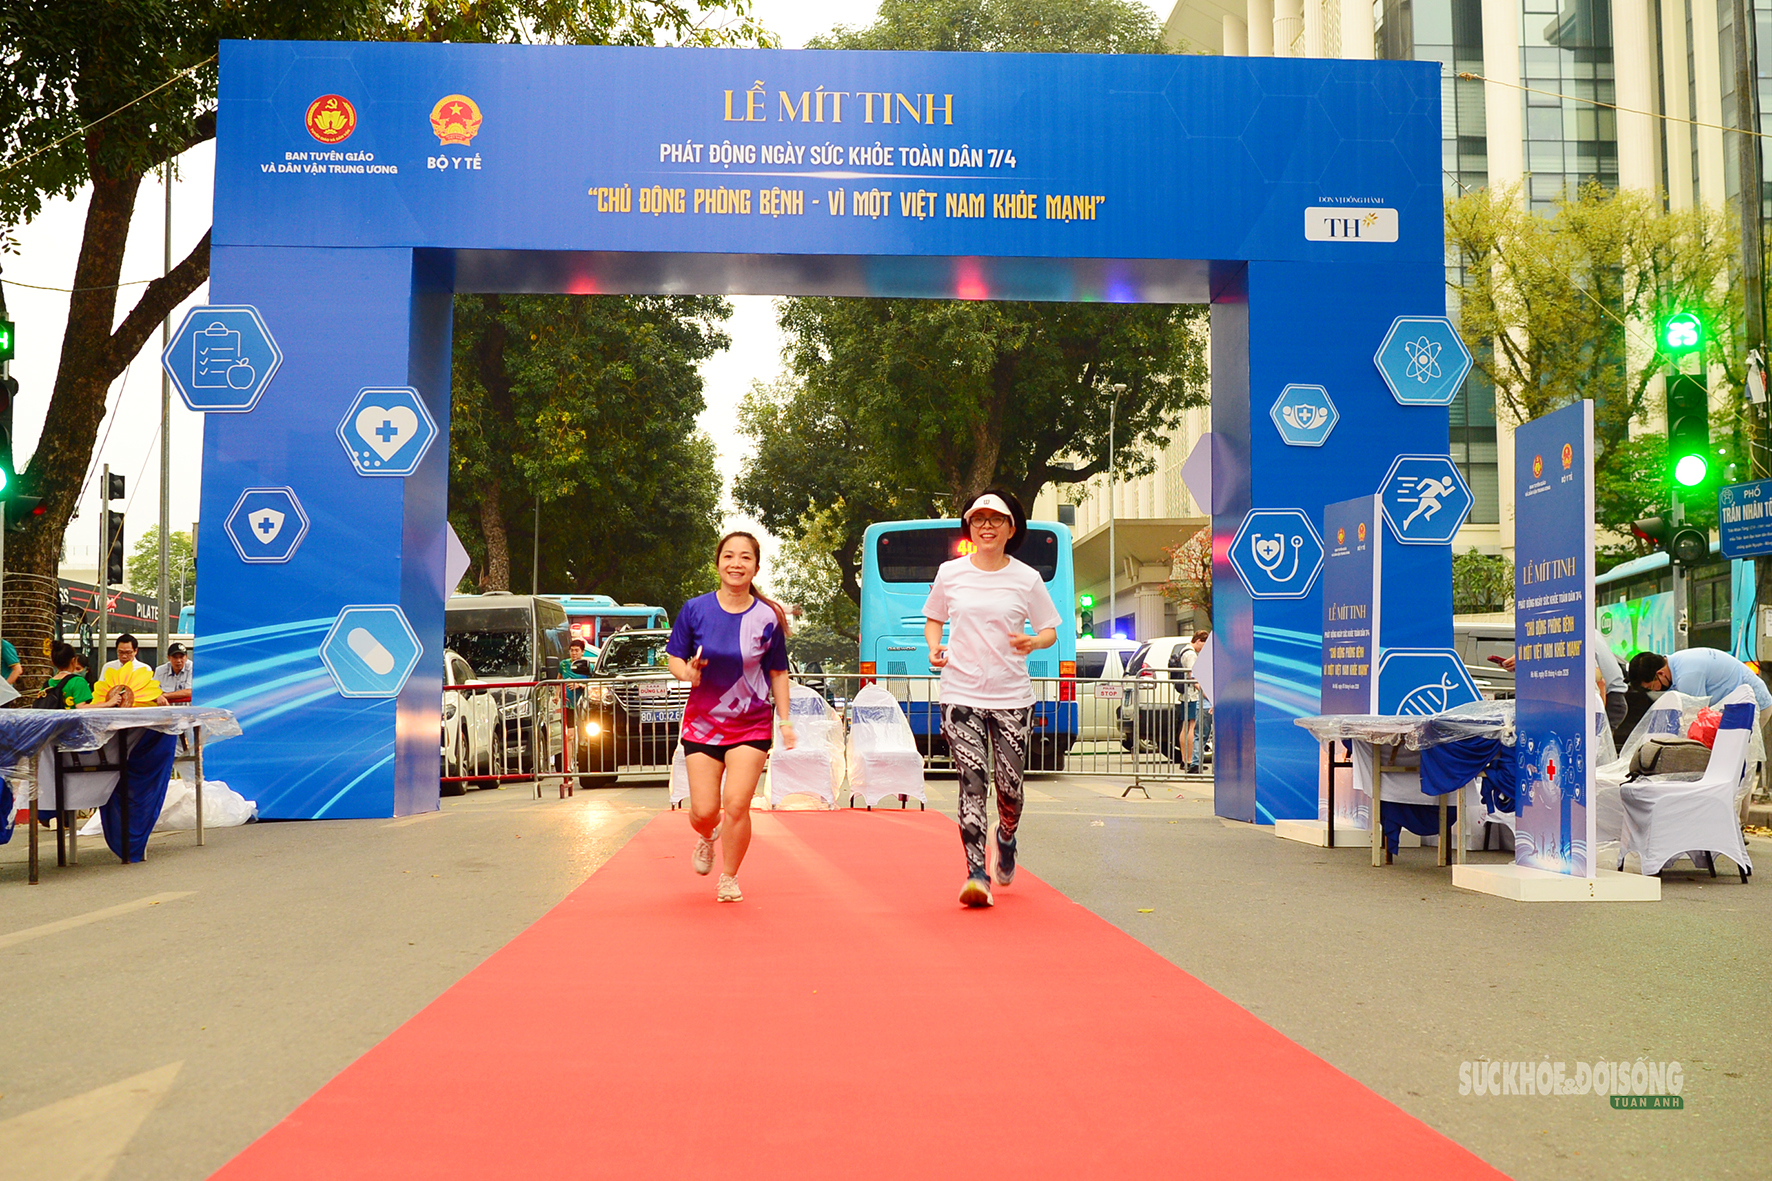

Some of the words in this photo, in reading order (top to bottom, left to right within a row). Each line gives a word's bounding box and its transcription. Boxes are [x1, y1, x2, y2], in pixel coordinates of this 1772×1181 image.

[723, 79, 767, 122] LỄ
[778, 85, 850, 123] MÍT
[856, 92, 954, 125] TINH
[285, 152, 308, 161] BAN
[309, 150, 344, 161] TUYÊN
[345, 150, 374, 162] GIÁO
[427, 154, 449, 172] BỘ
[451, 157, 463, 169] Y
[464, 152, 482, 170] TẾ
[660, 139, 704, 163] PHÁT
[709, 139, 756, 169] ĐỘNG
[761, 141, 805, 165] NGÀY
[810, 141, 844, 165] SỨC
[848, 141, 894, 166] KHỎE
[899, 143, 944, 167] TOÀN
[949, 144, 983, 168] DÂN
[987, 149, 1017, 168] 7/4
[261, 162, 277, 173] VÀ
[278, 162, 301, 173] DÂN
[303, 162, 326, 176] VẬN
[328, 164, 365, 174] TRUNG
[366, 164, 398, 174] ƯƠNG
[639, 185, 686, 216] ĐỘNG
[693, 186, 751, 214] PHÒNG
[760, 186, 804, 218] BỆNH
[828, 187, 845, 216] VÌ
[853, 188, 892, 220] MỘT
[900, 189, 937, 221] VIỆT
[946, 193, 985, 218] NAM
[993, 190, 1037, 220] KHỎE
[1324, 218, 1361, 237] TH
[1744, 485, 1761, 498] PHỐ
[1743, 500, 1763, 520] NHÂN
[1523, 559, 1533, 585] LỄ
[1535, 559, 1551, 583] MÍT
[1552, 557, 1576, 580] TINH
[136, 603, 159, 621] PILATE
